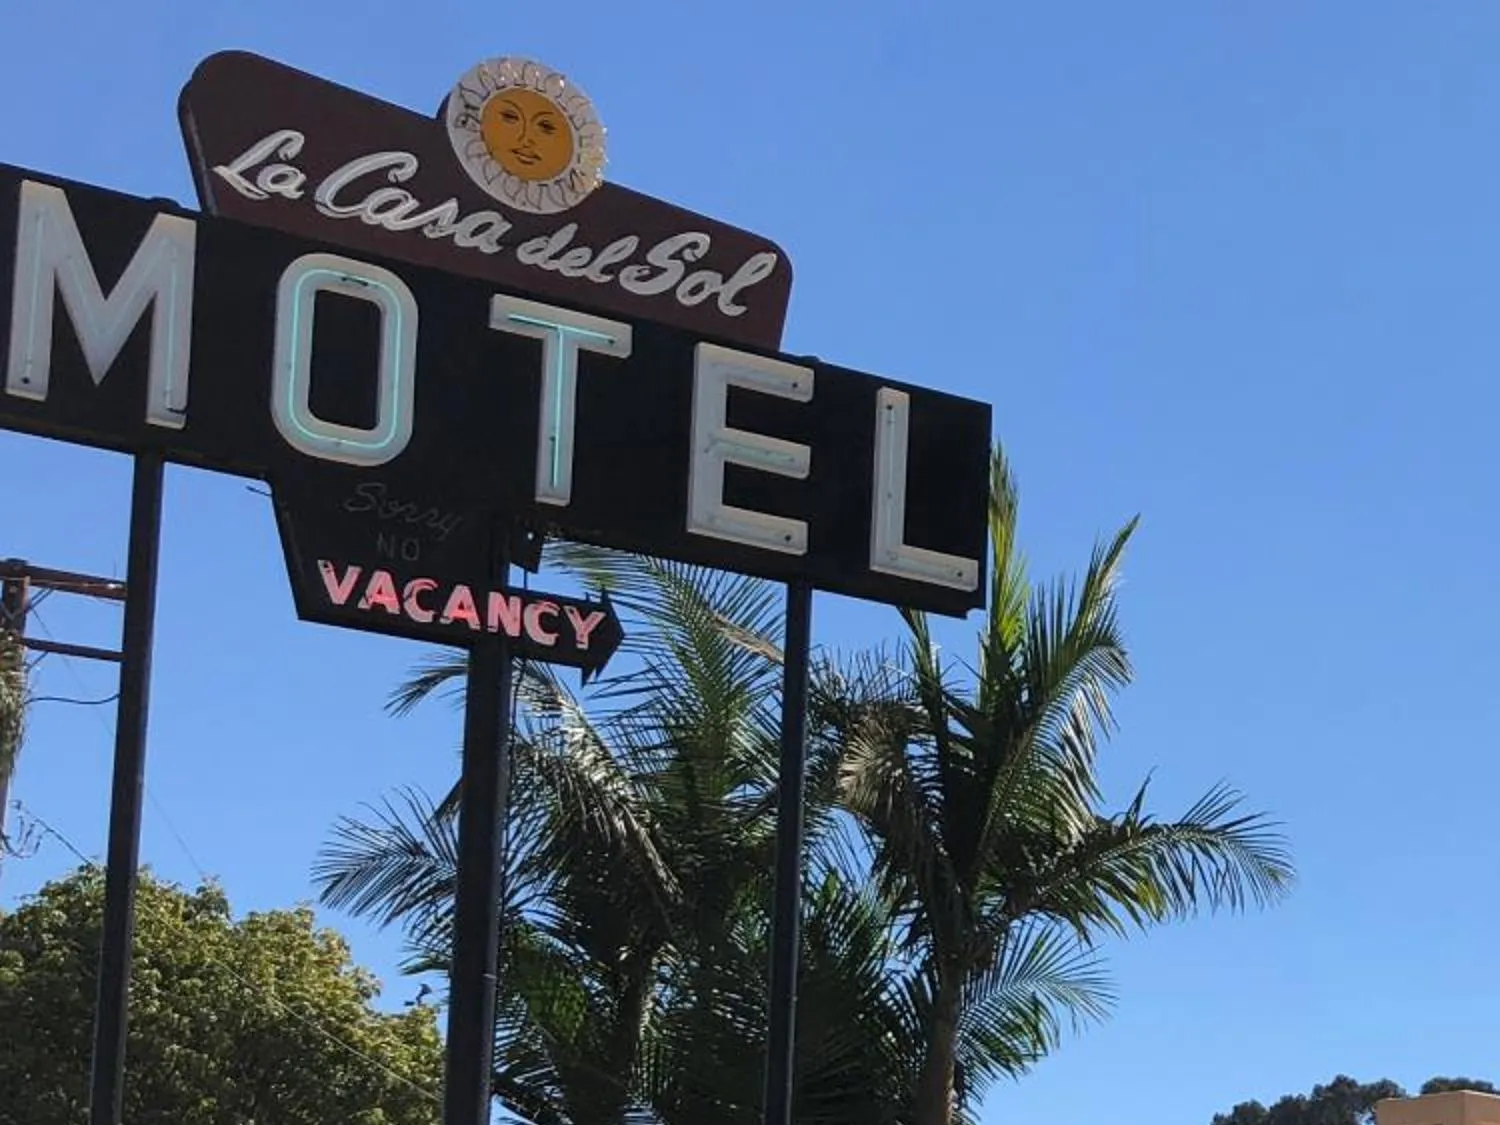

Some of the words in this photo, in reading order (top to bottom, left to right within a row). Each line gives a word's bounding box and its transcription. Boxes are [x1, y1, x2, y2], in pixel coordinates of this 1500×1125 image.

[213, 129, 305, 200] La
[314, 150, 513, 254] Casa
[515, 222, 628, 283] del
[618, 231, 778, 317] Sol
[4, 178, 980, 593] MOTEL
[317, 558, 607, 650] VACANCY
[376, 531, 420, 561] NO
